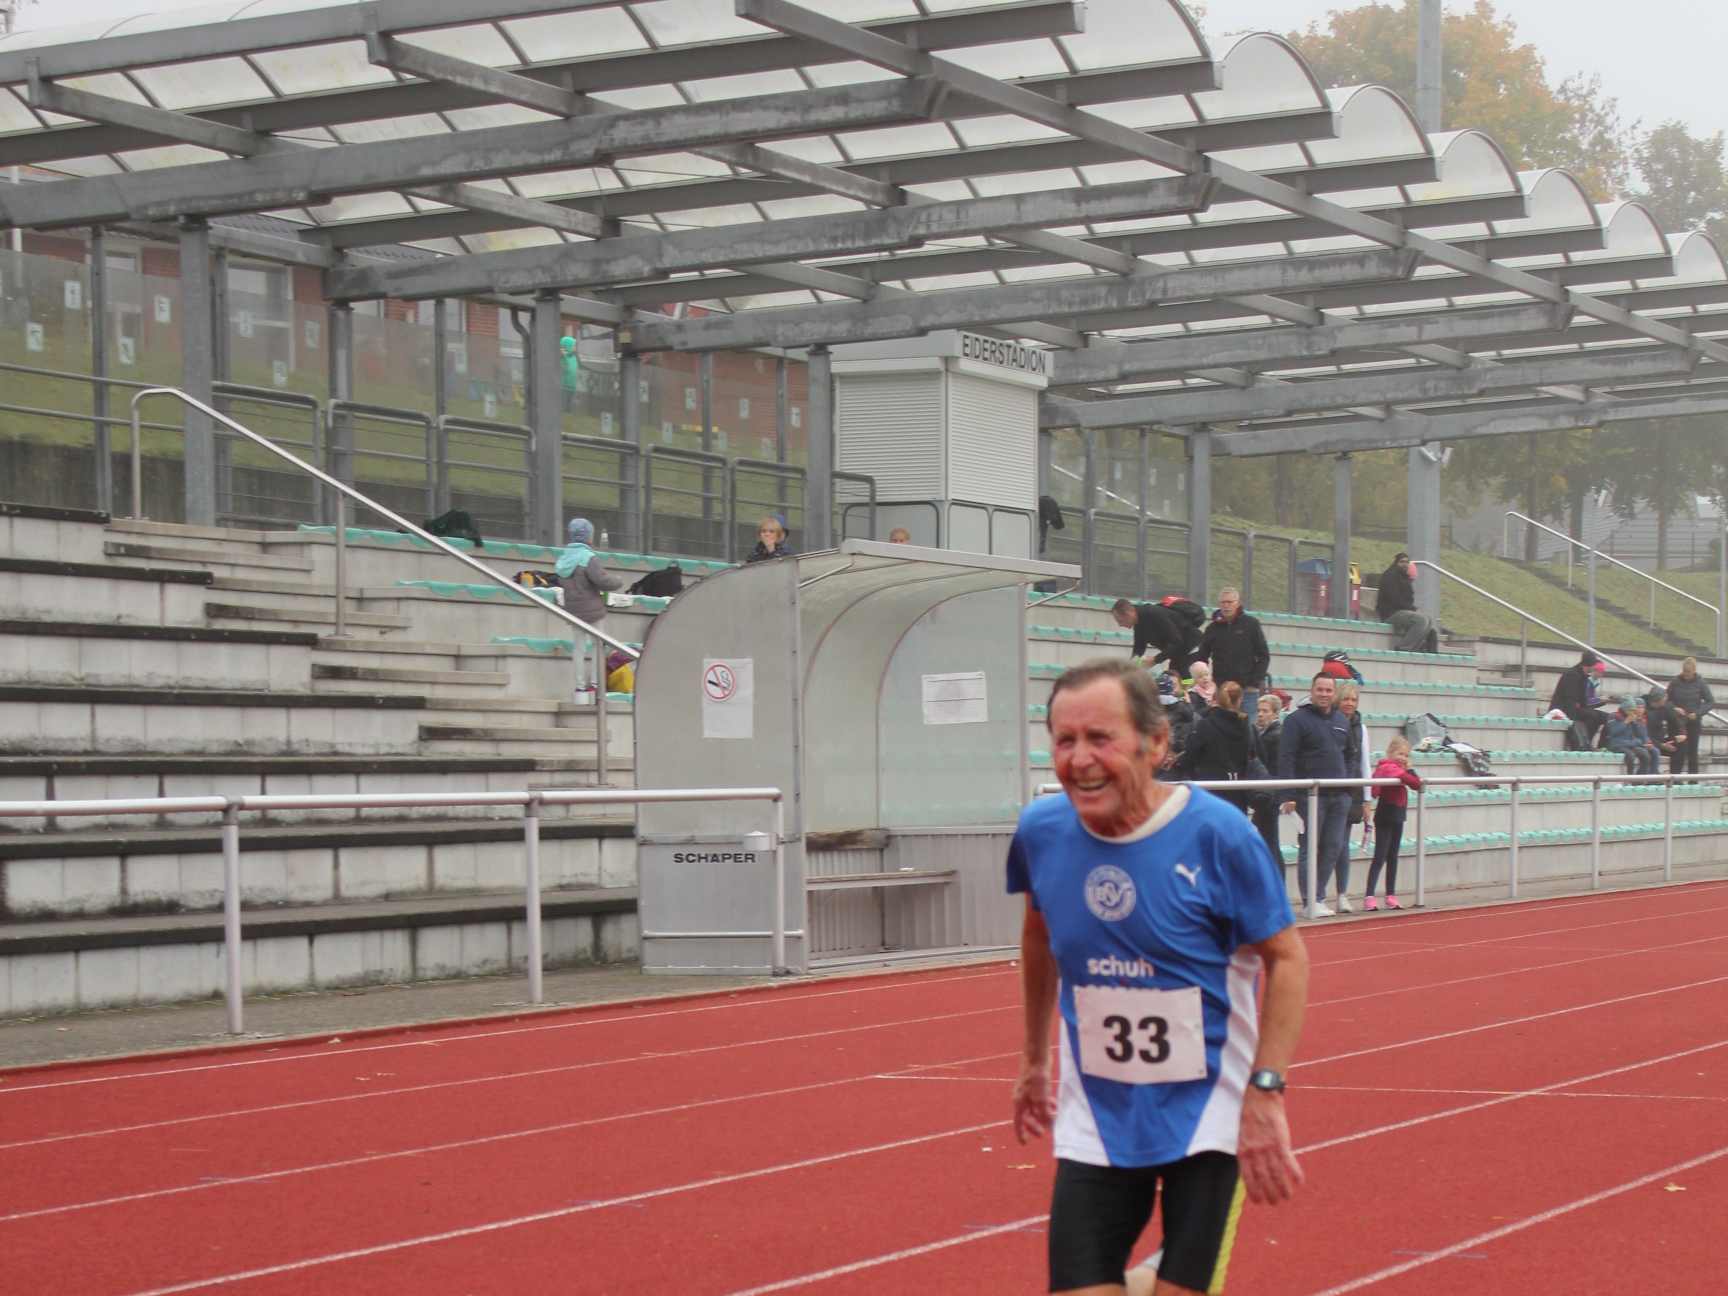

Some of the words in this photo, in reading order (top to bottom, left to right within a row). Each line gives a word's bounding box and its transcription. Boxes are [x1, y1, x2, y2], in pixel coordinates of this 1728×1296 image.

[962, 334, 1046, 374] EIDERSTADION
[1087, 955, 1154, 977] schuh
[1103, 1015, 1171, 1064] 33
